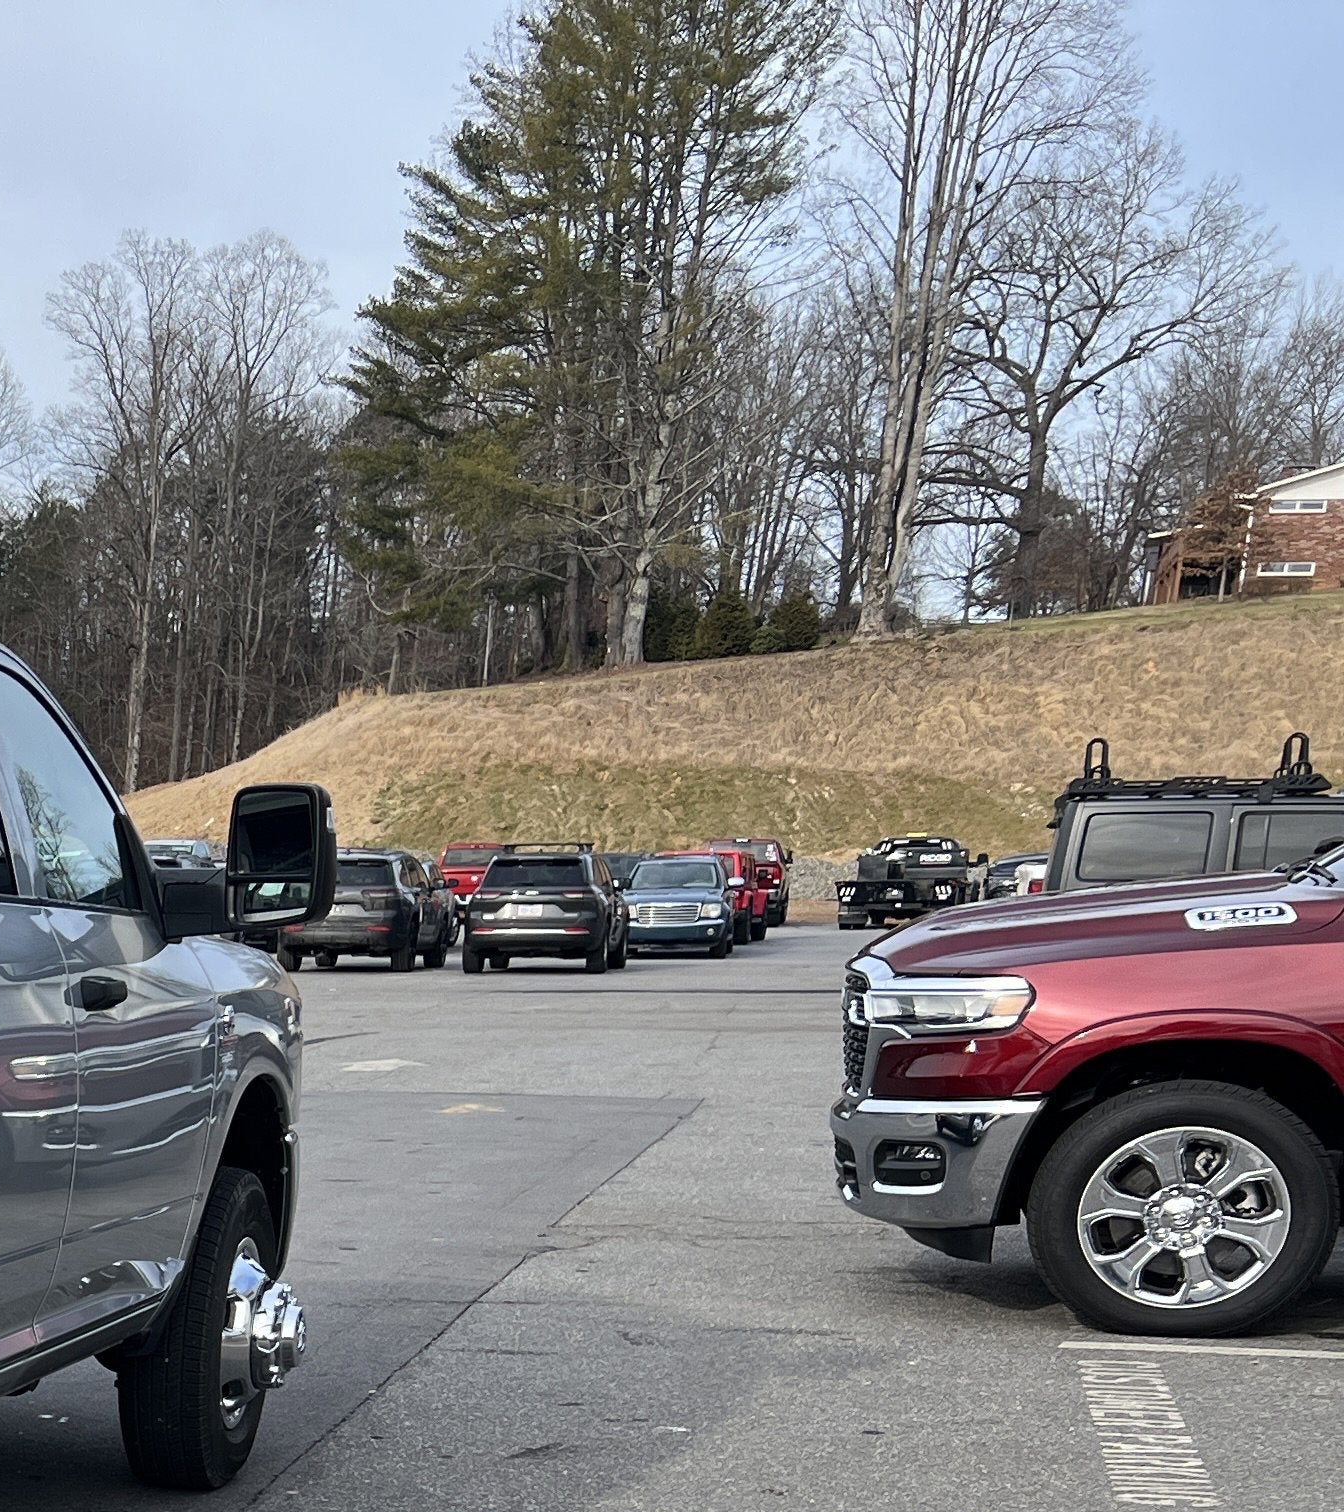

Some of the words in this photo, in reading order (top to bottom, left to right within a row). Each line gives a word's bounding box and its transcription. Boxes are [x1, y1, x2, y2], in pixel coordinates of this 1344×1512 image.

[1201, 906, 1280, 921] 1500
[1076, 1359, 1186, 1429] CUSTOMER
[1096, 1431, 1225, 1508] PARKING
